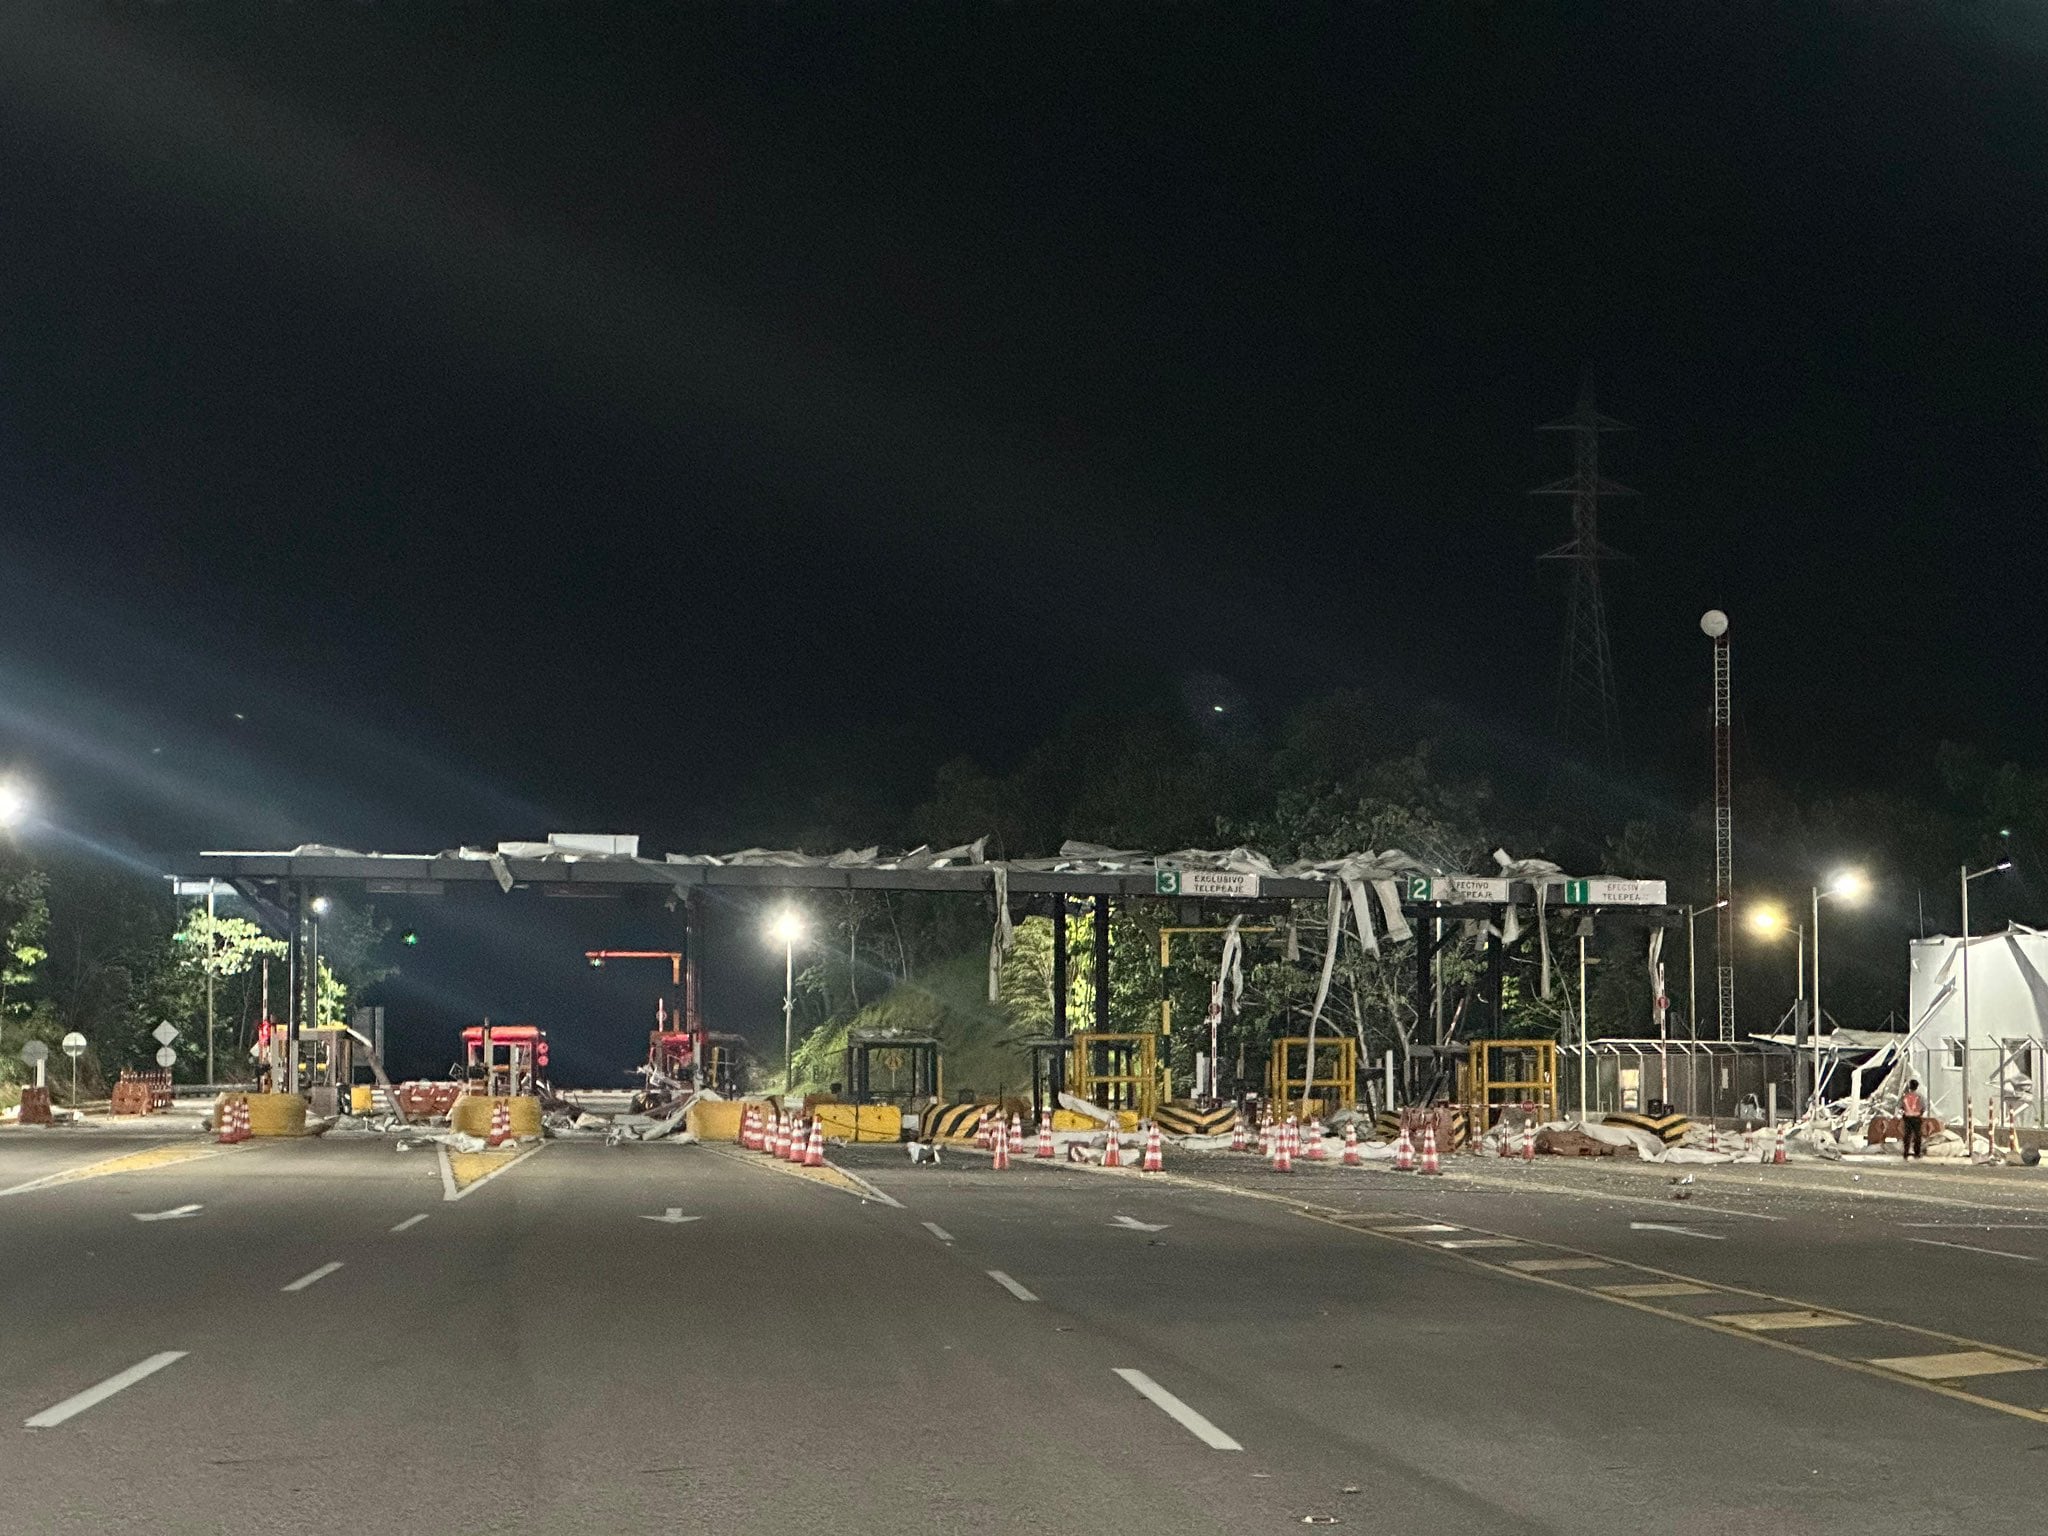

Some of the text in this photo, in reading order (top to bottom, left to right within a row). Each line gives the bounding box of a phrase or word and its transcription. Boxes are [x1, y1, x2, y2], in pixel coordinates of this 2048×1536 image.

[1160, 872, 1176, 892] 3
[1194, 875, 1244, 884] EXCLUSIVO
[1456, 881, 1489, 889] FECTIVO
[1413, 878, 1427, 900] 2
[1573, 881, 1581, 902] 1
[1607, 883, 1639, 892] EFECTIV
